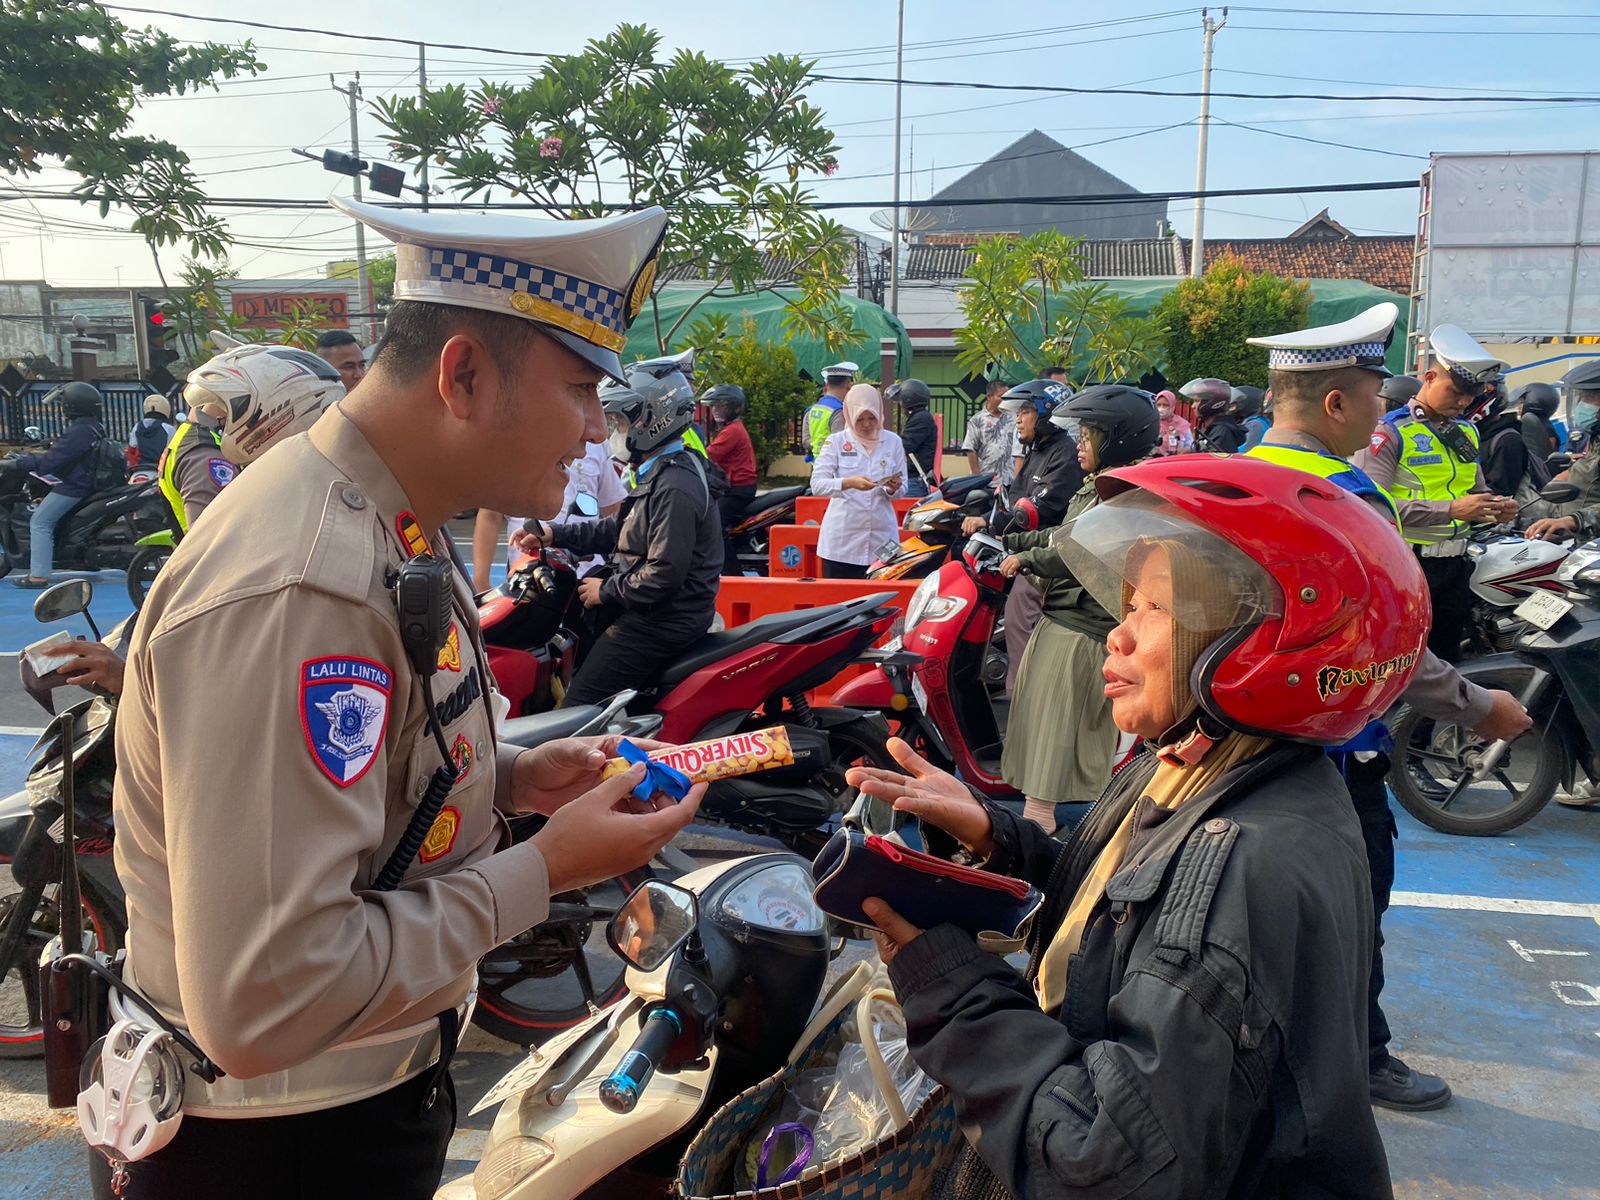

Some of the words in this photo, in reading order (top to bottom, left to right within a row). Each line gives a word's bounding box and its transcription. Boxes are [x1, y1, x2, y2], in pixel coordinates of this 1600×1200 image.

[648, 412, 673, 439] NHK
[310, 663, 346, 677] LALU
[351, 664, 387, 685] LINTAS
[653, 733, 769, 773] SILVERQUE
